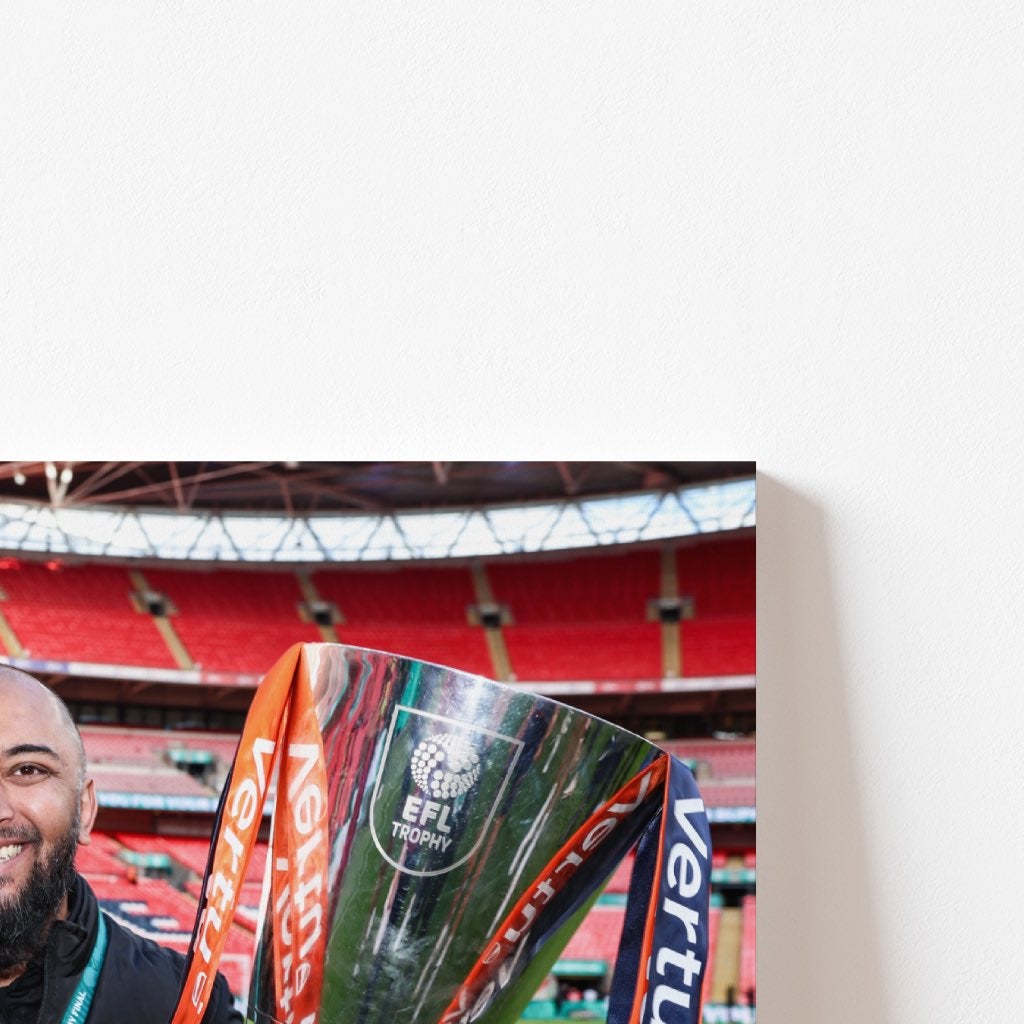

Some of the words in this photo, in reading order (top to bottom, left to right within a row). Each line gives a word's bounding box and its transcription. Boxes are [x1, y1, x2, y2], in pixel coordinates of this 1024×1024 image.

[402, 794, 451, 833] EFL
[392, 821, 453, 853] TROPHY
[72, 992, 87, 1017] FINAL
